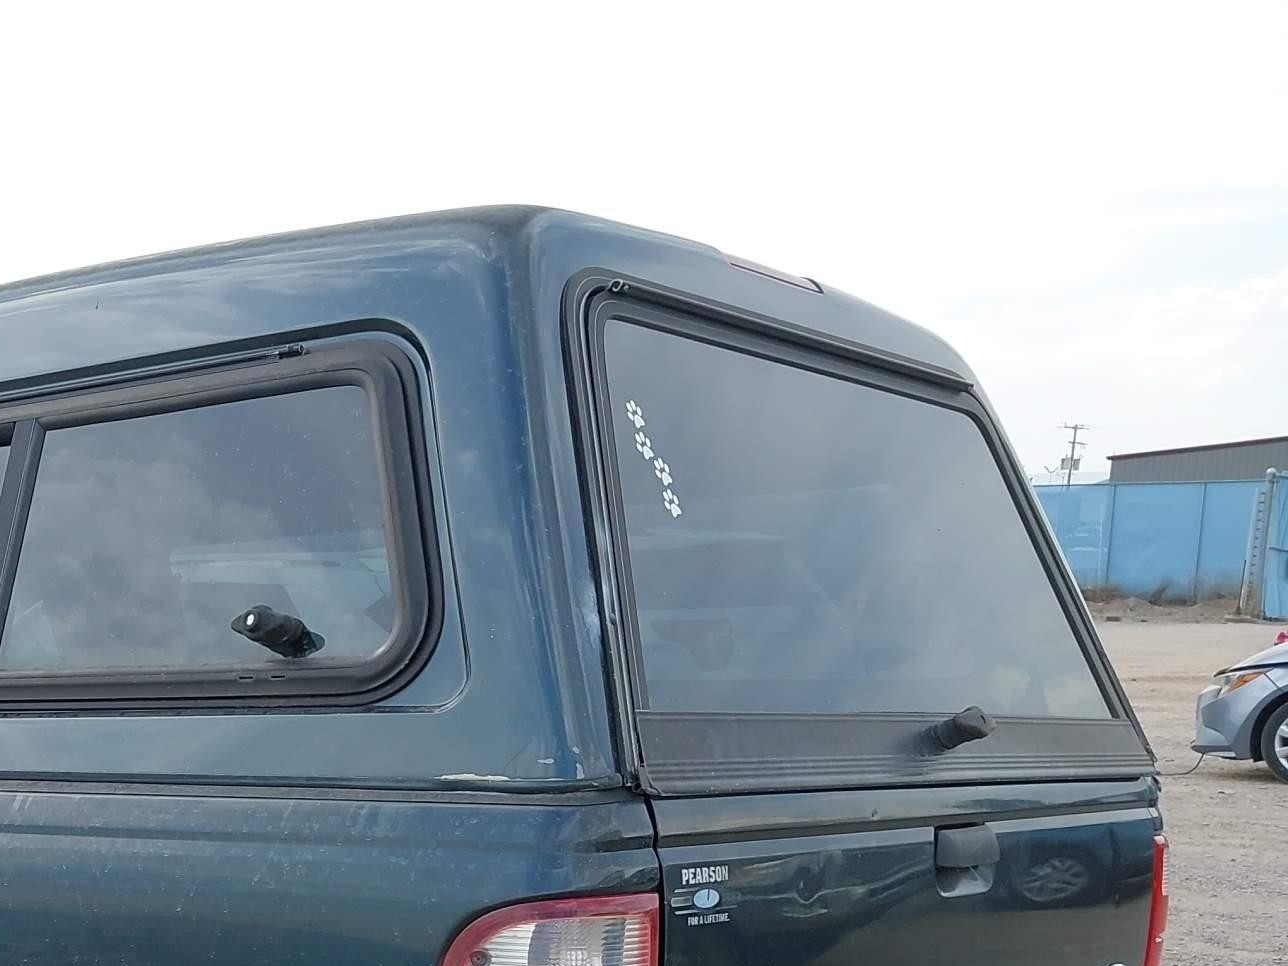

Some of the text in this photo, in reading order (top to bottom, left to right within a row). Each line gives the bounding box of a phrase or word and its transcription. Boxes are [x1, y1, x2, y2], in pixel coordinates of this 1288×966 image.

[681, 865, 729, 885] PEARSON
[687, 916, 699, 927] FOR
[698, 914, 703, 924] A
